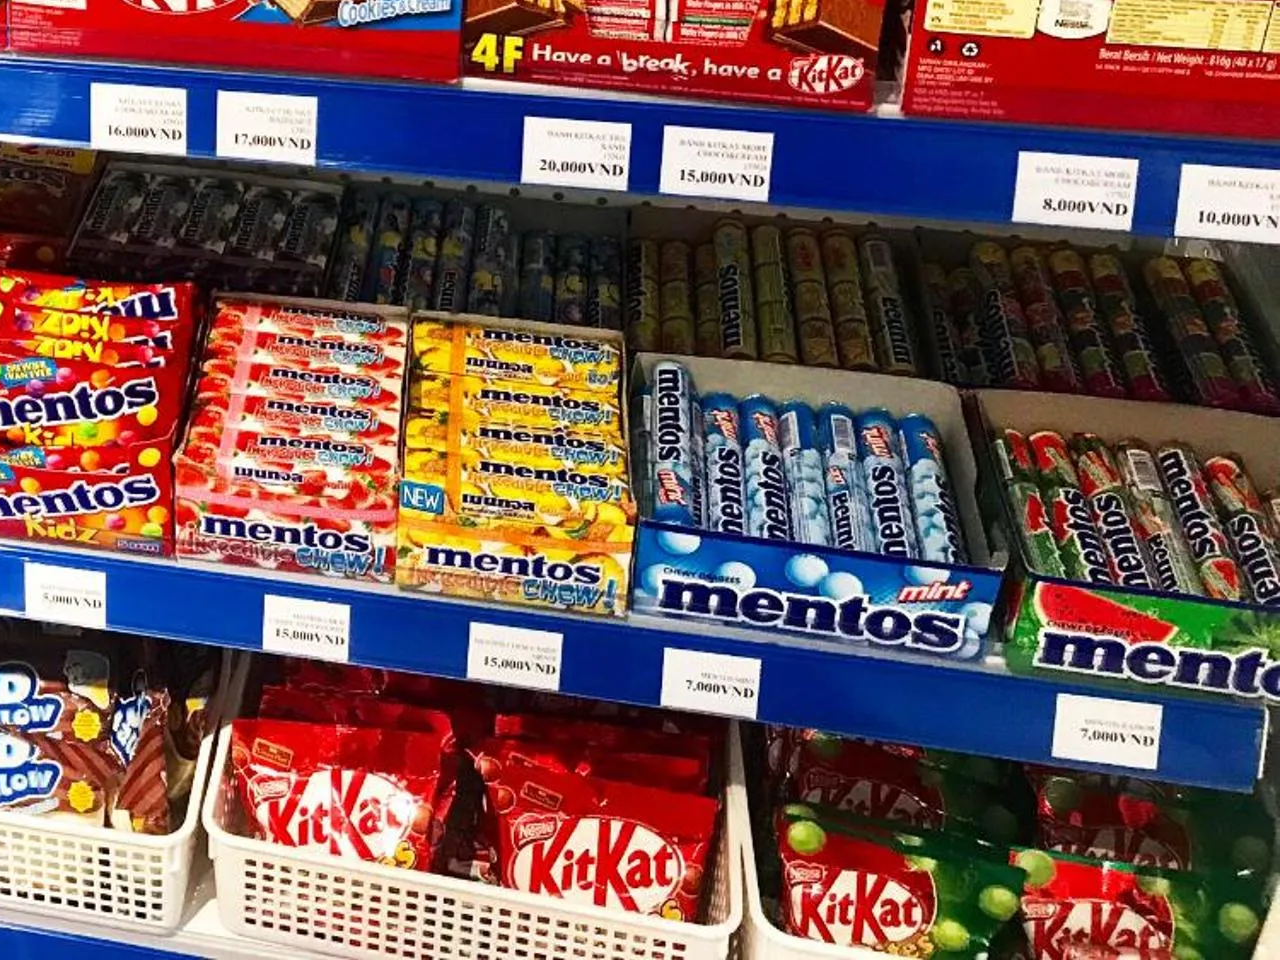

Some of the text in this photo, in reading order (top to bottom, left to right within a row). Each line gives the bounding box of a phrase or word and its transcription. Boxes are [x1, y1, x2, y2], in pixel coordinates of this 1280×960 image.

[472, 33, 524, 73] 4F
[533, 44, 592, 64] Have
[597, 54, 611, 66] a
[703, 59, 759, 78] have
[767, 68, 781, 80] a
[790, 54, 865, 94] KitKat
[1157, 52, 1171, 63] Net
[1173, 53, 1203, 66] Weight
[108, 125, 182, 140] 16,000VND
[234, 133, 311, 150] 17,000VND
[538, 159, 624, 176] 20,000VND
[679, 169, 765, 187] 15,000VND
[1042, 198, 1128, 216] 8,000VND
[279, 335, 378, 354] mentos
[482, 329, 600, 351] mentos
[272, 368, 374, 388] mentos
[267, 400, 370, 420] mentos
[480, 388, 600, 411] mentos
[657, 368, 681, 461] mentos
[260, 435, 365, 455] mentos
[479, 426, 604, 450] mentos
[479, 460, 609, 487] mentos
[404, 486, 439, 508] NEW
[1160, 450, 1220, 558] mentos
[25, 514, 99, 543] Kidz
[204, 516, 369, 553] mentos
[427, 546, 601, 584] mentos
[664, 567, 697, 578] CHEWY
[898, 581, 970, 603] mint
[662, 580, 962, 648] mentos
[275, 628, 344, 646] 15,000VND
[483, 657, 555, 675] 15,000VND
[686, 680, 754, 698] 7,000VND
[1080, 728, 1154, 747] 7,000VND
[268, 769, 404, 862] KitKat
[528, 818, 674, 910] KitKat
[801, 870, 919, 945] KitKat
